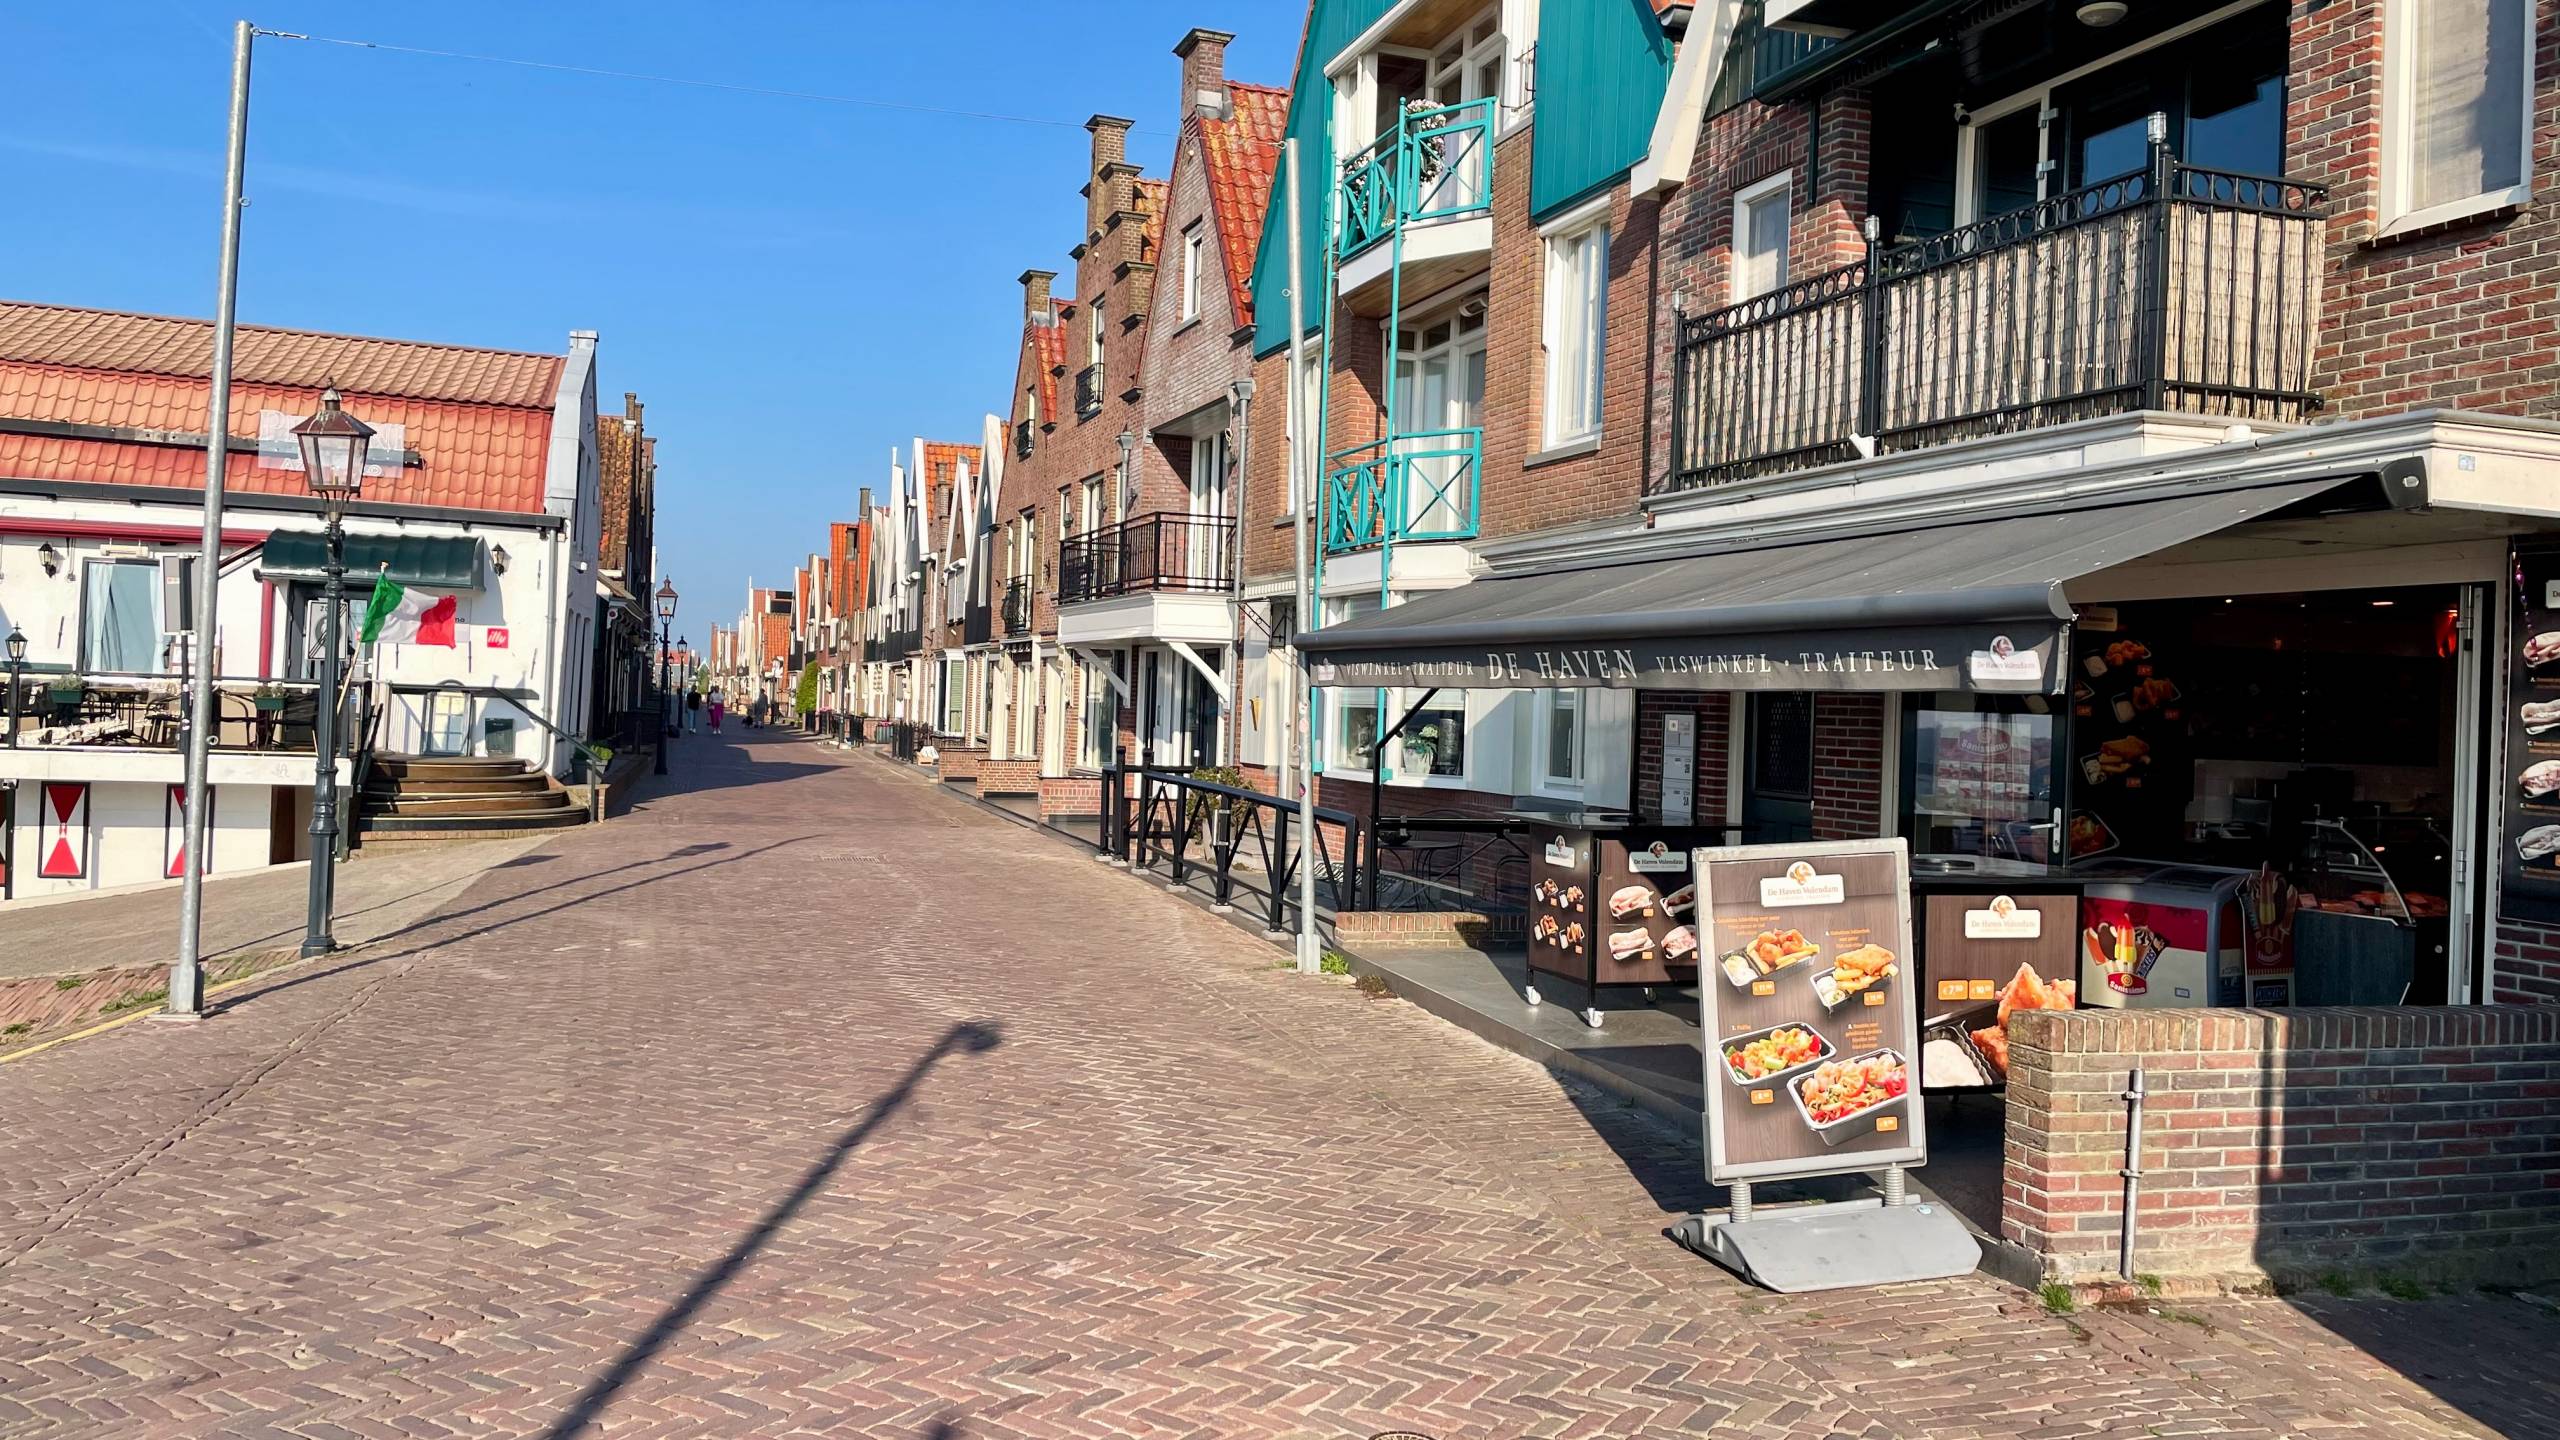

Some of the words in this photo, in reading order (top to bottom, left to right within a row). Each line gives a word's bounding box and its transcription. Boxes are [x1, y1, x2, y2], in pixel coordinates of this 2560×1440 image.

[488, 631, 507, 646] illy
[1346, 662, 1403, 676] VISWINKEL
[1413, 661, 1474, 676] TRAITEUR
[1487, 653, 1521, 680] DE
[1535, 649, 1638, 680] HAVEN
[1656, 653, 1772, 674] VISWINKEL
[1799, 649, 1941, 673] TRAITEUR
[1767, 888, 1778, 896] De
[1779, 887, 1802, 896] Haven
[1802, 885, 1839, 894] Volendam
[1971, 920, 1980, 928] De
